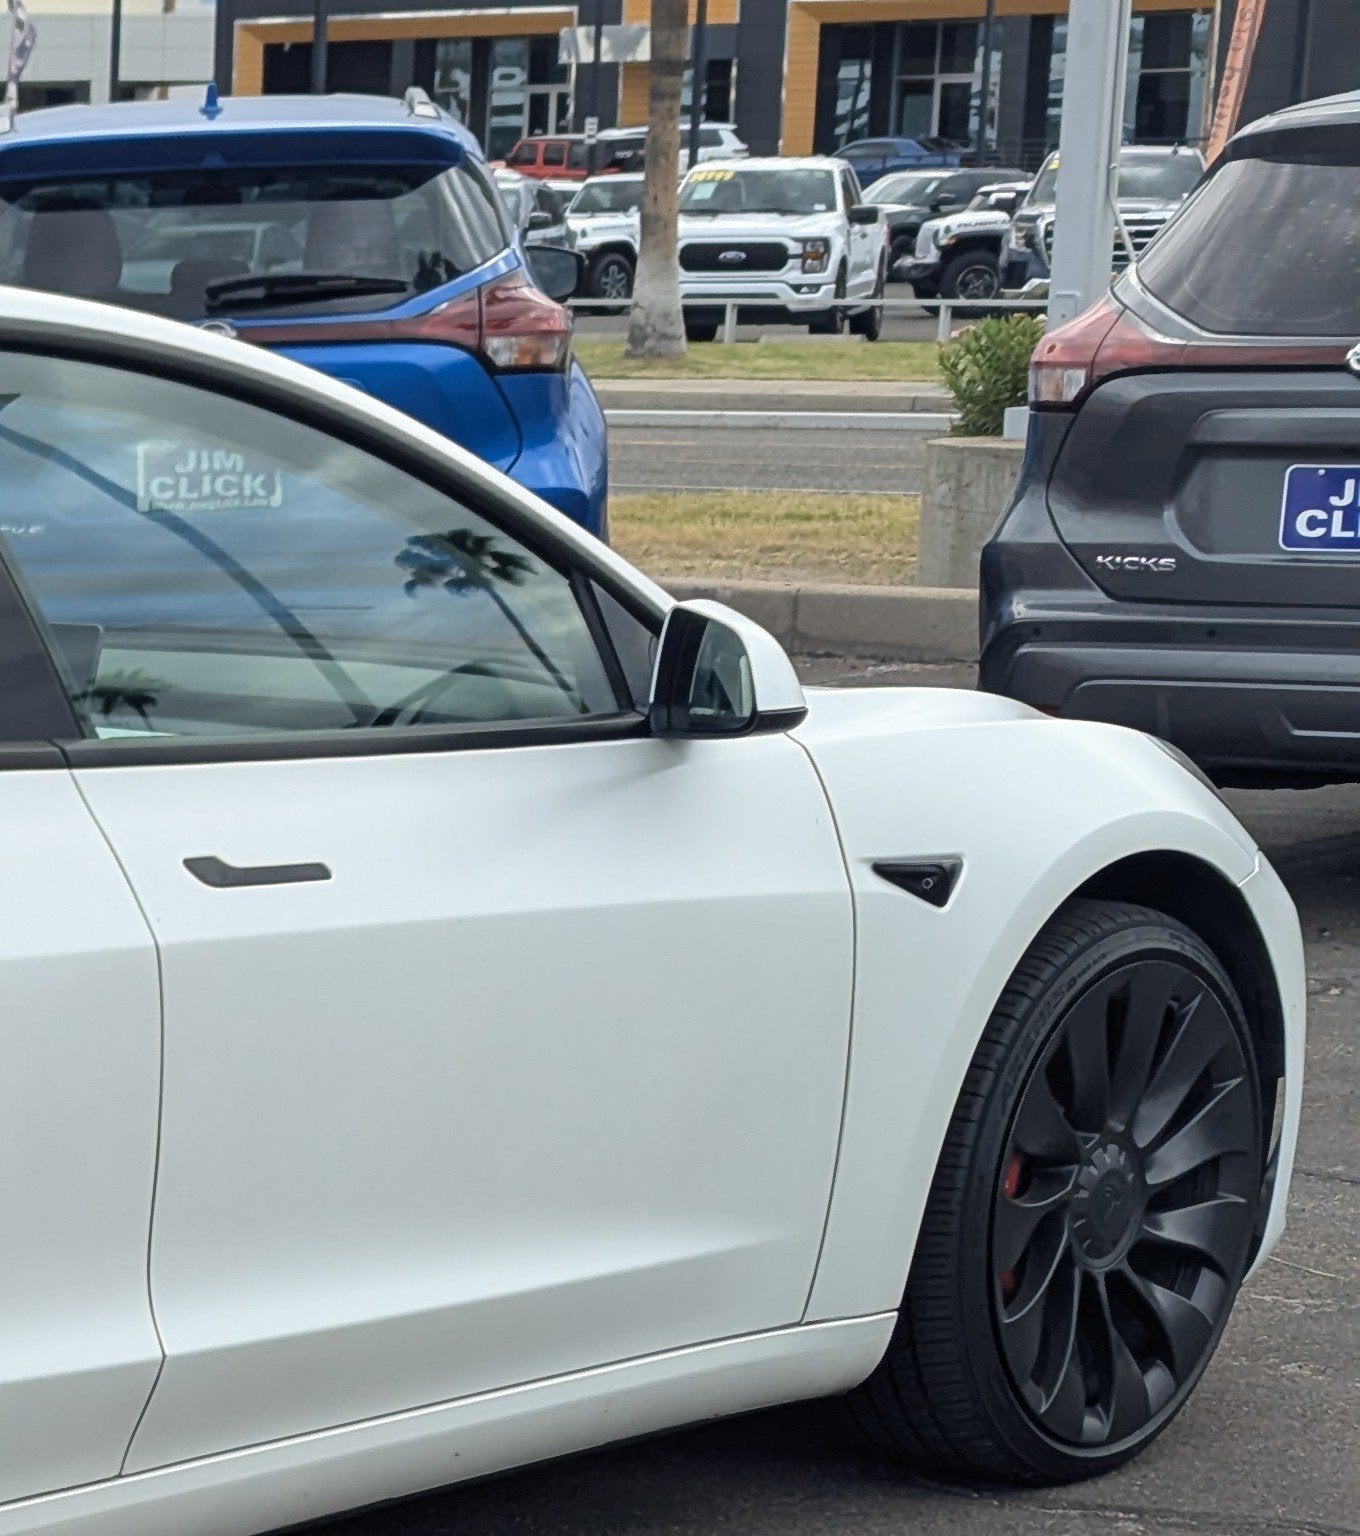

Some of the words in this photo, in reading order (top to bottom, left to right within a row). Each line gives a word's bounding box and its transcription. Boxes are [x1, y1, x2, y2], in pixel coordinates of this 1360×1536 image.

[175, 450, 244, 473] JIM
[149, 474, 268, 499] CLICK
[1295, 509, 1360, 538] CL
[1096, 555, 1176, 572] KICKS
